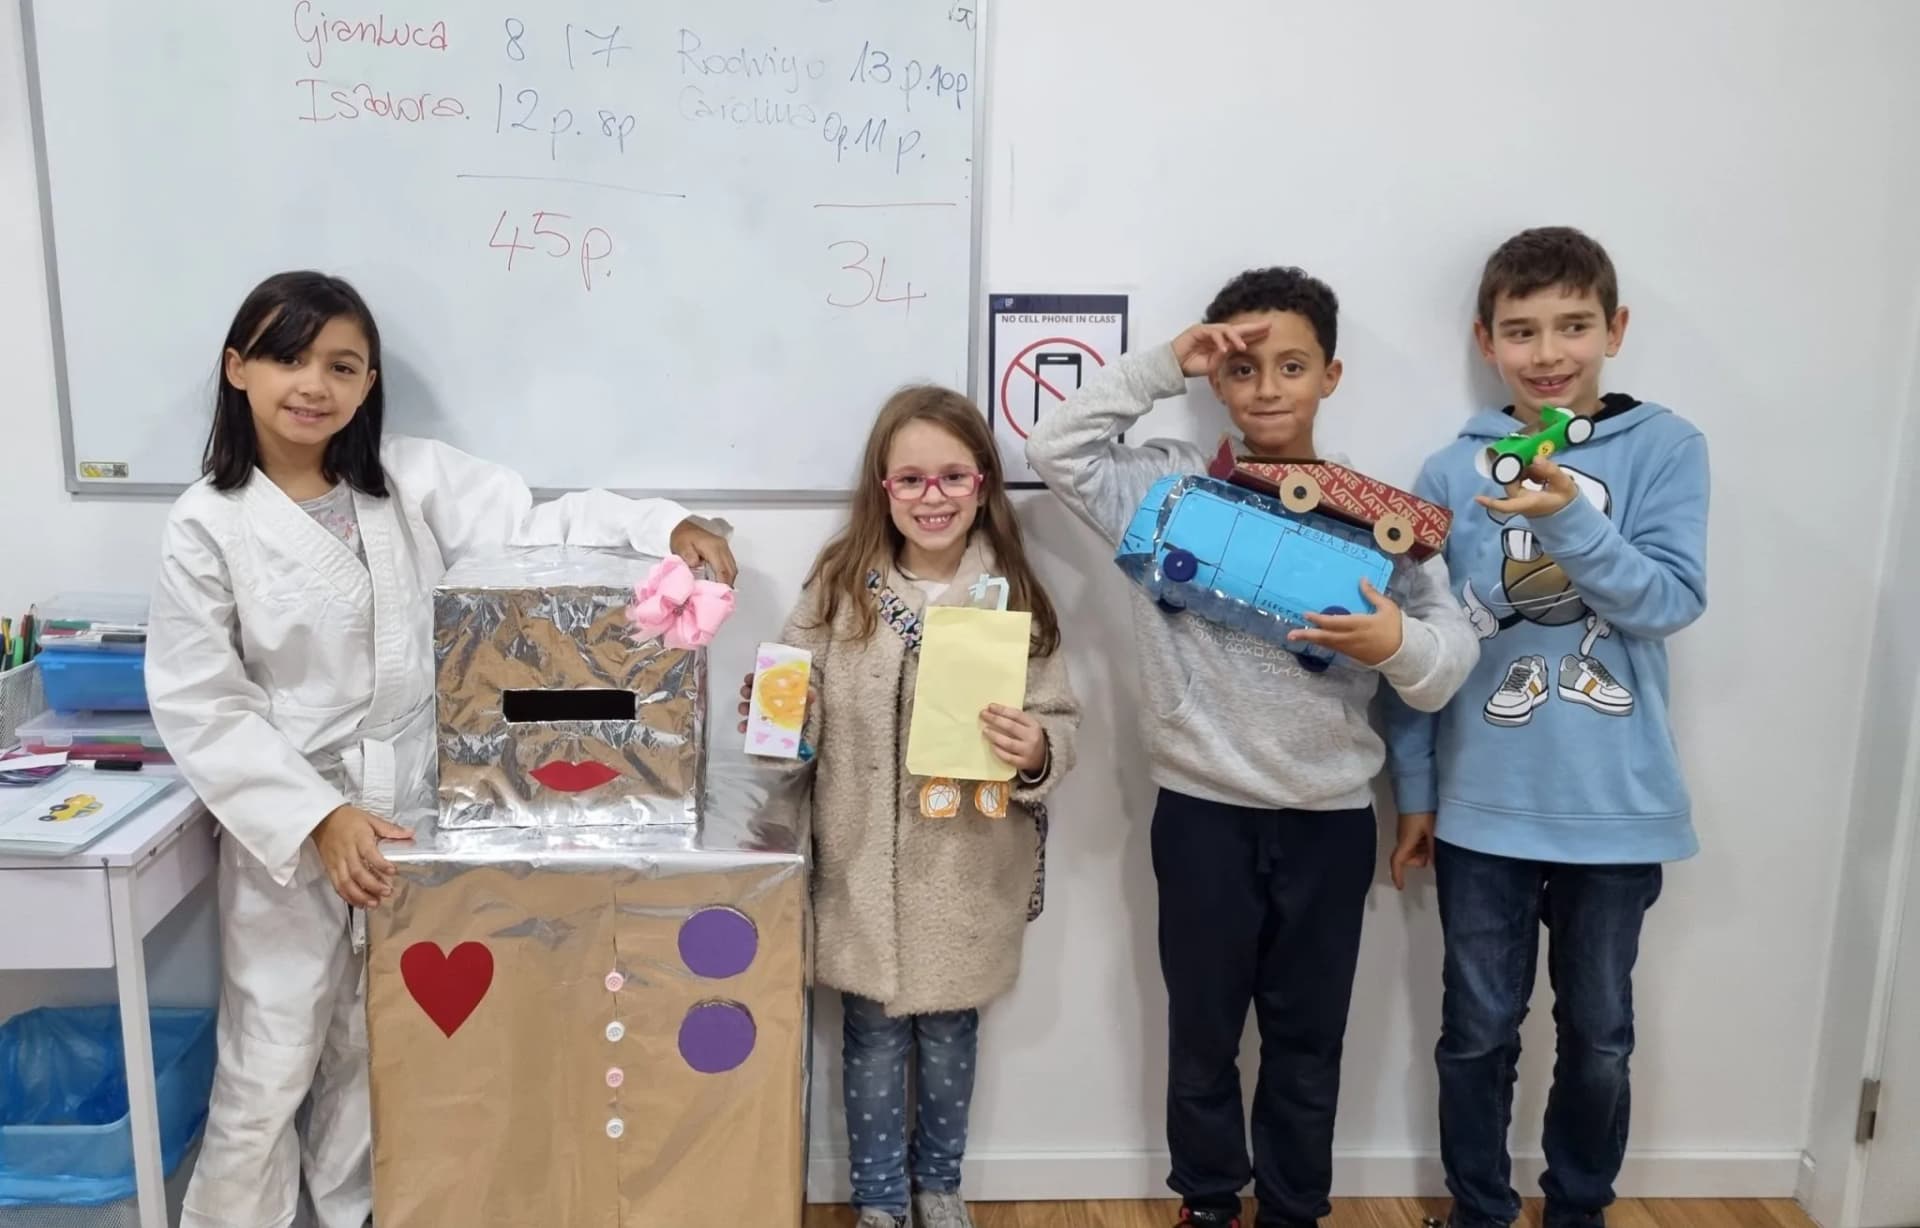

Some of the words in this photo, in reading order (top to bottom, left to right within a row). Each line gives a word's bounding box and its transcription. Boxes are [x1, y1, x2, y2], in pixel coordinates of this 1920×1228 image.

[504, 18, 525, 61] 8
[826, 240, 927, 318] 34
[1001, 314, 1016, 323] NO
[1018, 314, 1040, 323] CELL
[1041, 314, 1074, 323] PHONE
[1076, 314, 1087, 323] IN
[1088, 315, 1117, 324] CLASS
[1331, 481, 1366, 513] VANS
[1387, 490, 1423, 526] VANS
